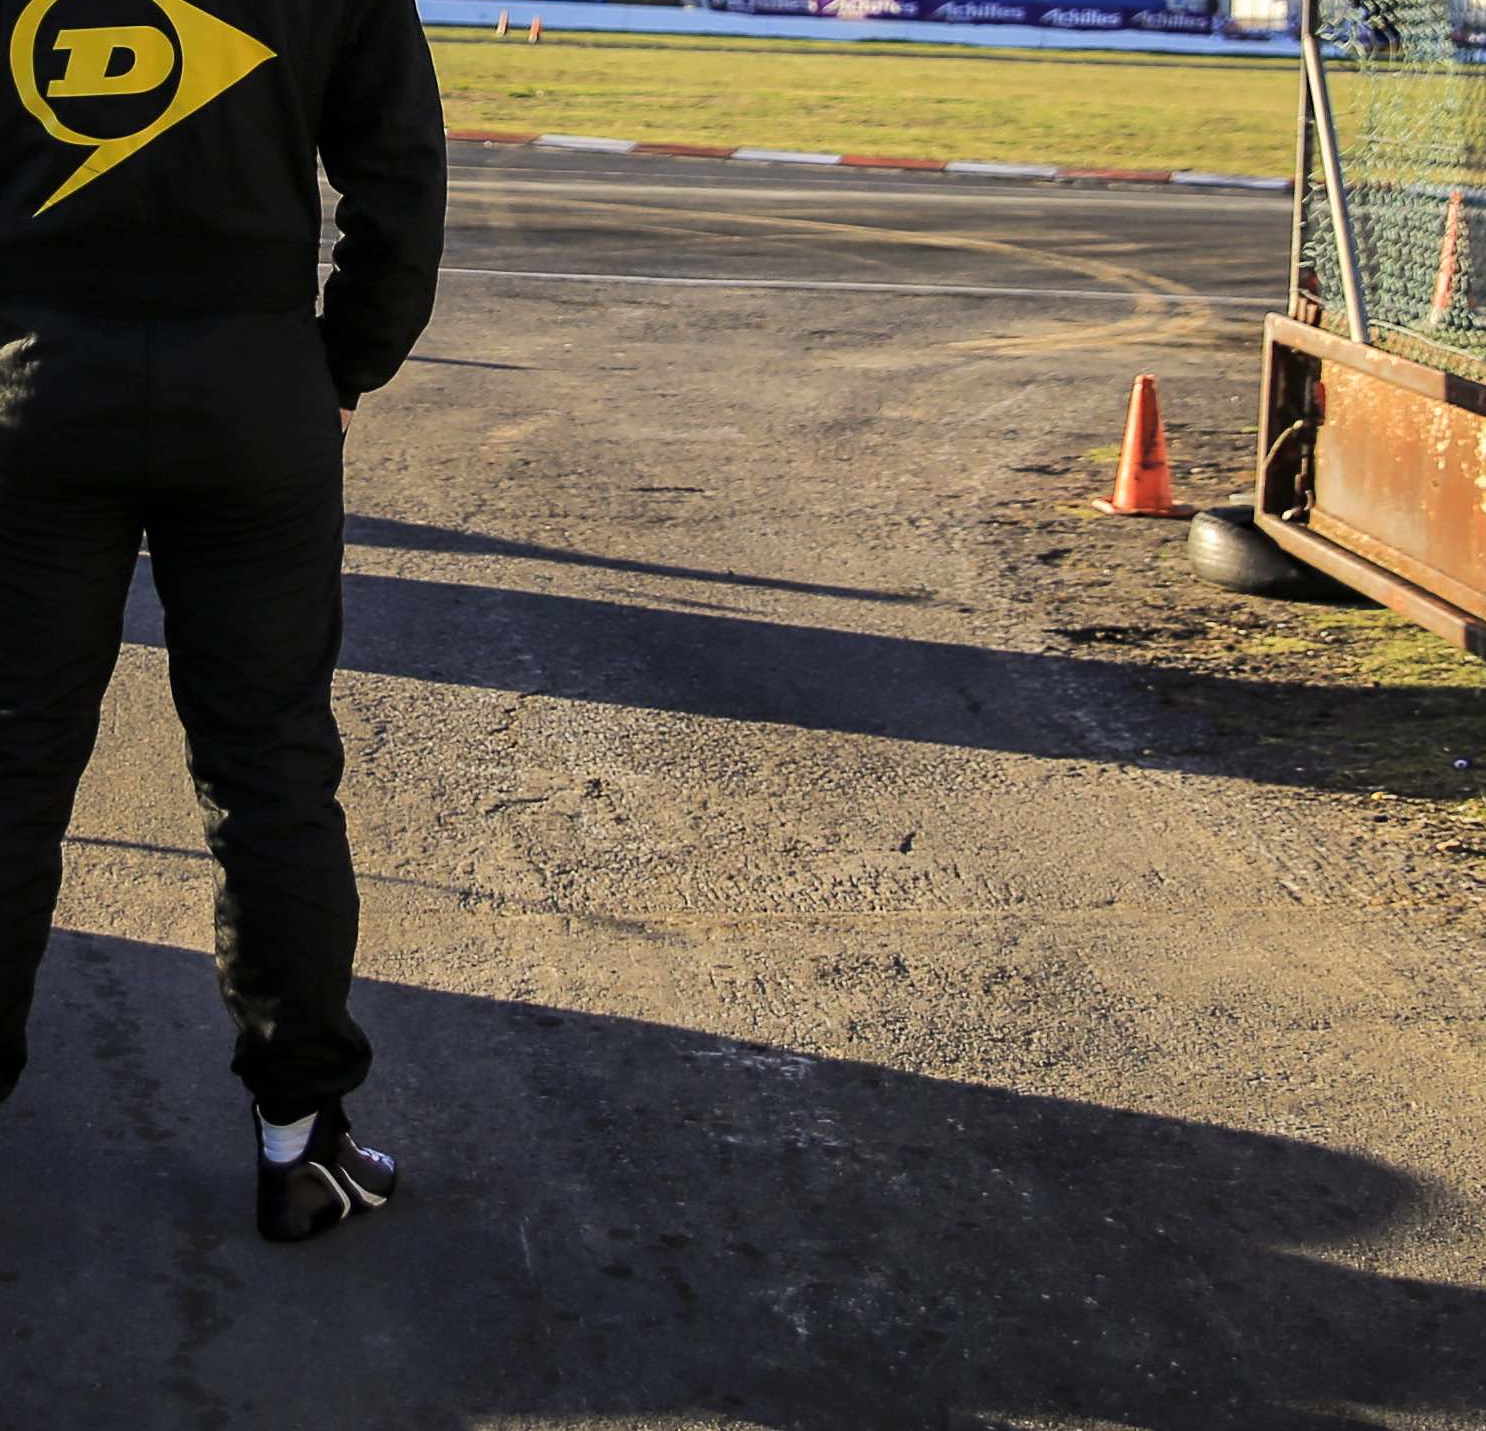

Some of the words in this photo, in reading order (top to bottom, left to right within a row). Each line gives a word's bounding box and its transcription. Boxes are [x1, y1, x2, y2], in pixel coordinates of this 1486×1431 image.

[932, 0, 1027, 21] Achilles
[1040, 7, 1123, 26] Achilles
[46, 25, 175, 98] D
